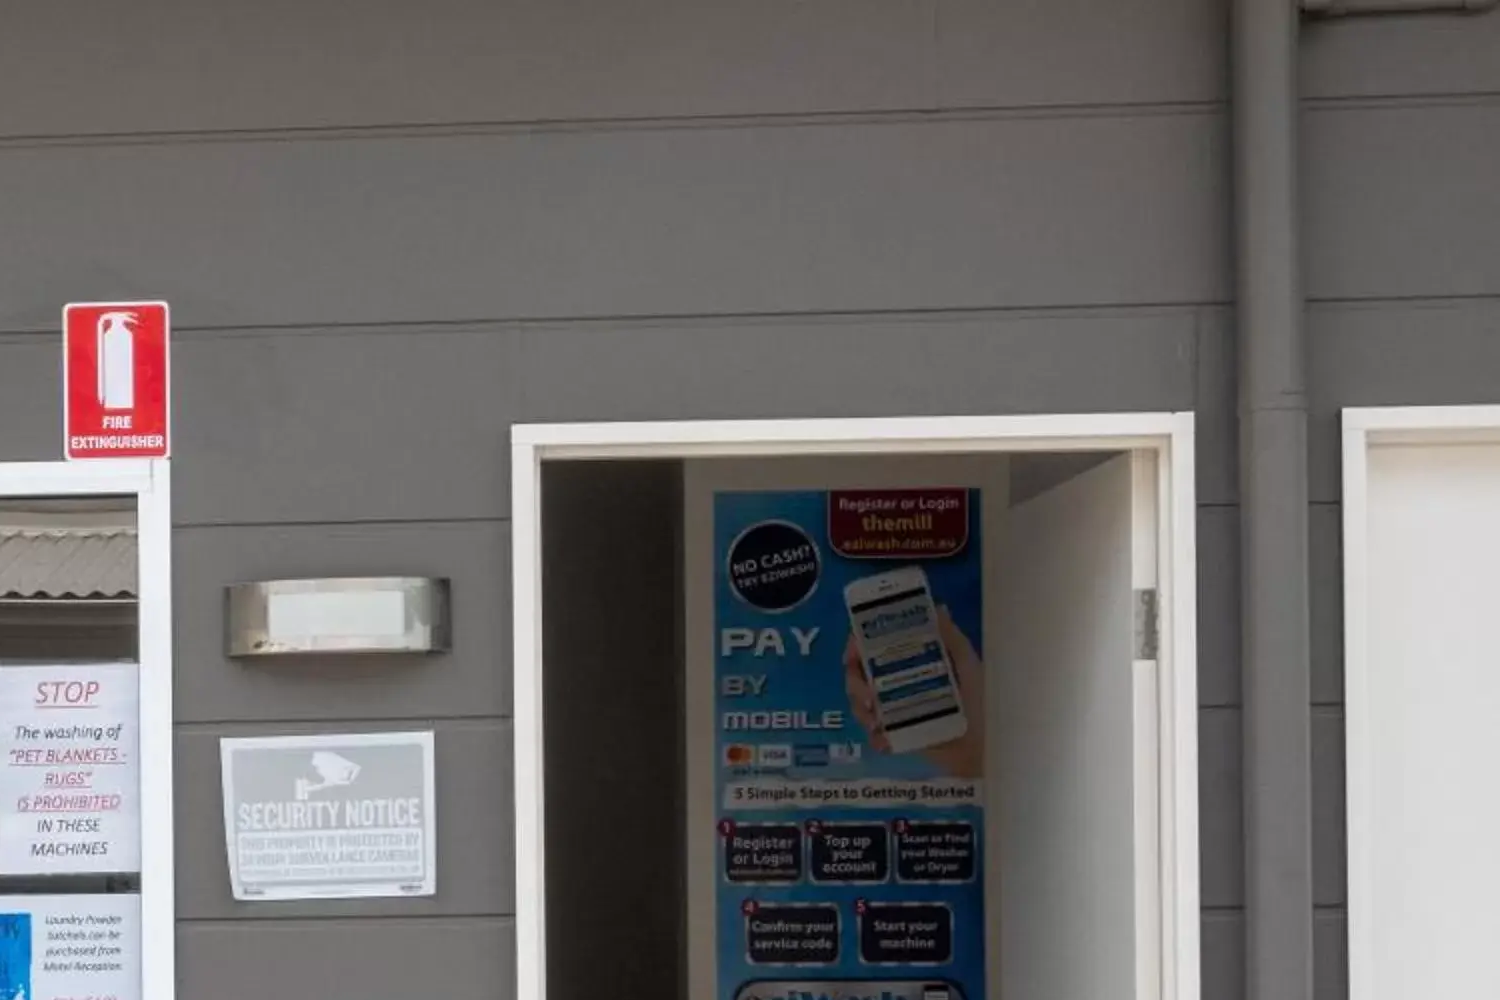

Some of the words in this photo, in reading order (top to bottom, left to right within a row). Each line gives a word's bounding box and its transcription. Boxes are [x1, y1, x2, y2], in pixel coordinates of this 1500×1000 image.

[102, 415, 133, 429] FIRE
[71, 435, 165, 449] EXTINGUISHER
[838, 498, 898, 513] Register
[900, 499, 917, 510] or
[919, 497, 959, 511] Login
[862, 513, 933, 533] themill
[732, 559, 758, 577] NO
[760, 544, 811, 569] CASH?
[720, 627, 821, 657] PAY
[36, 681, 100, 704] STOP
[721, 674, 768, 696] BY
[722, 710, 845, 730] MOBILE
[14, 725, 40, 740] The
[44, 725, 104, 741] washing
[106, 723, 124, 741] of
[46, 748, 118, 764] BLANKETS
[747, 786, 797, 802] Simple
[799, 786, 840, 801] Steps
[843, 786, 859, 799] to
[861, 786, 918, 802] Getting
[920, 785, 975, 799] Started
[17, 797, 30, 812] IS
[32, 795, 122, 811] PROHIBITED
[237, 800, 340, 830] SECURITY
[345, 797, 421, 828] NOTICE
[37, 819, 53, 833] IN
[56, 818, 102, 833] THESE
[732, 837, 794, 851] Register
[823, 834, 850, 849] Top
[852, 837, 872, 849] up
[30, 842, 109, 857] MACHINES
[831, 850, 864, 862] your
[732, 854, 749, 865] or
[752, 852, 794, 867] Login
[821, 861, 876, 873] account
[751, 920, 804, 933] Confirm
[805, 922, 835, 935] your
[873, 920, 907, 932] Start
[908, 923, 938, 934] your
[753, 938, 799, 950] service
[801, 937, 833, 950] code
[879, 937, 935, 949] machine
